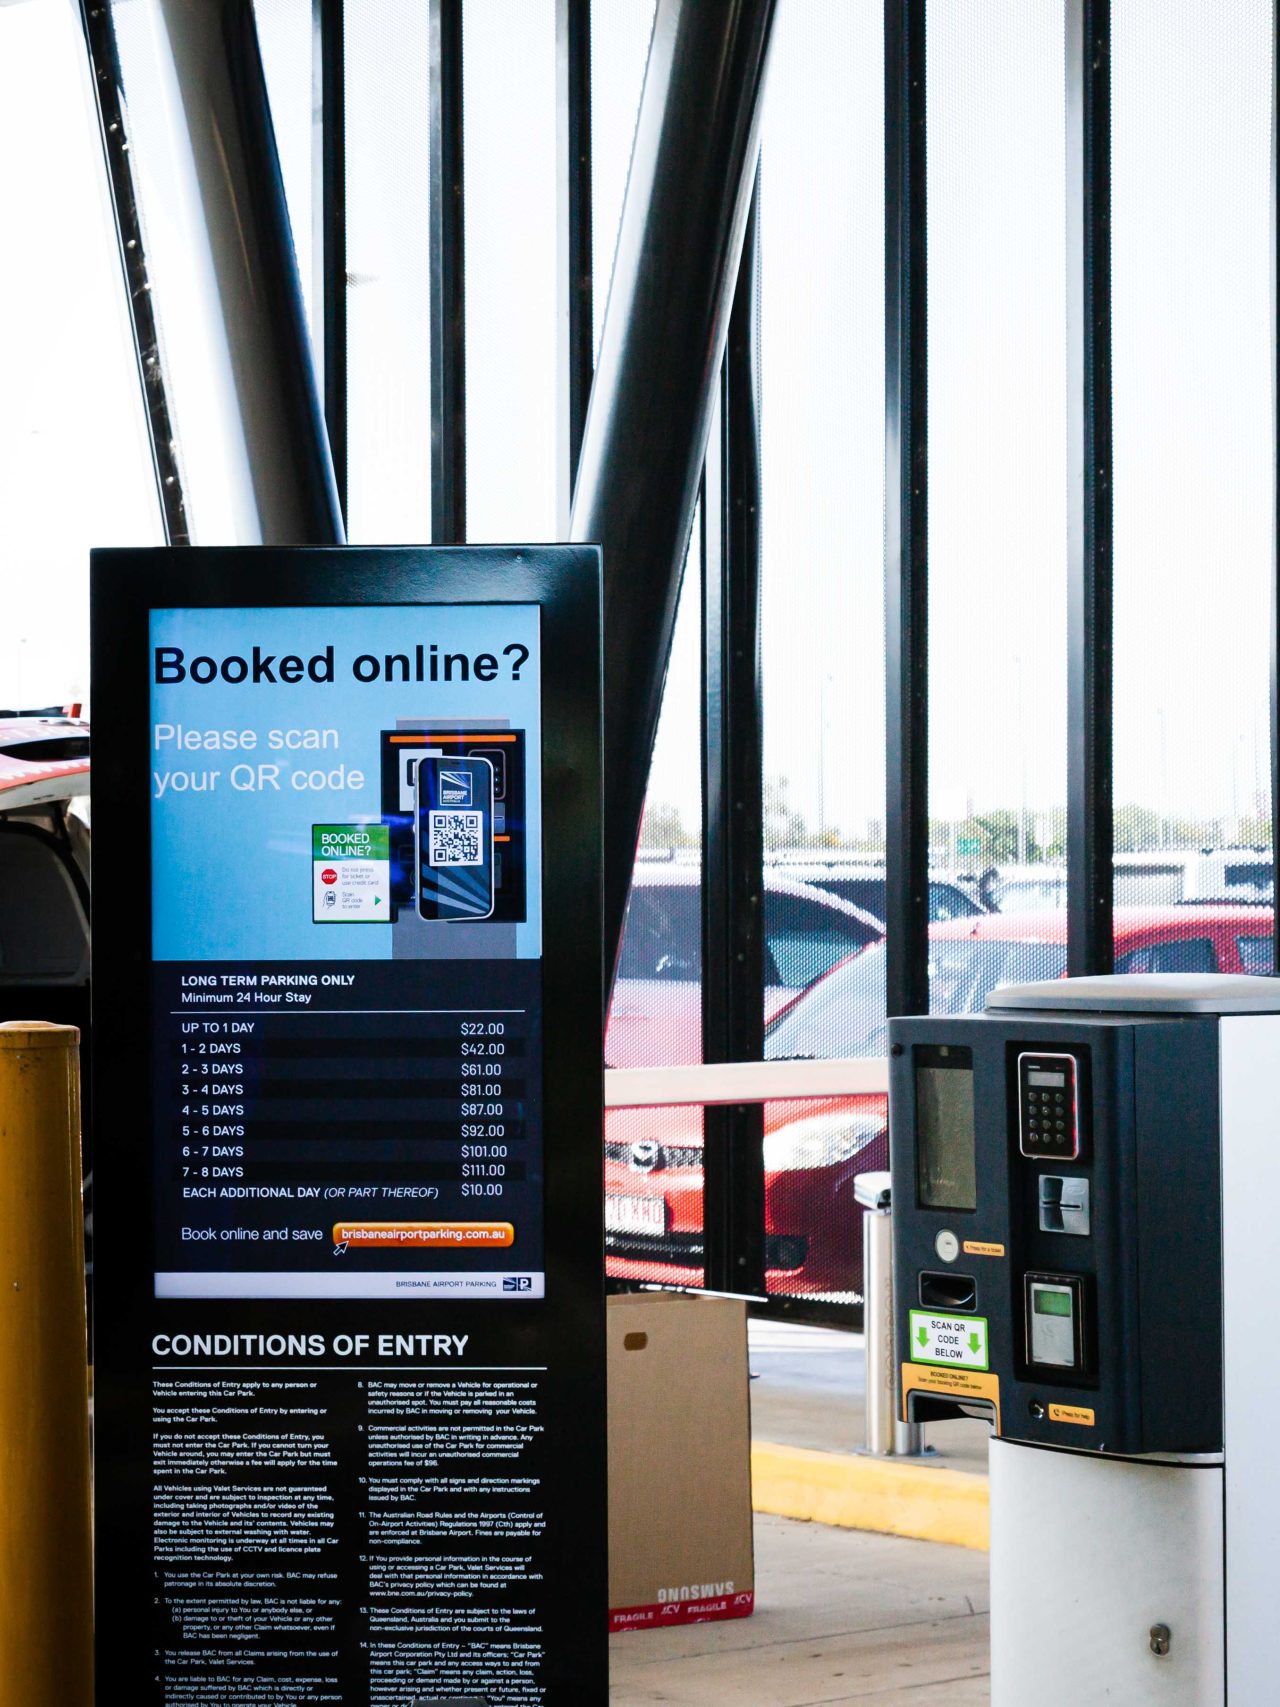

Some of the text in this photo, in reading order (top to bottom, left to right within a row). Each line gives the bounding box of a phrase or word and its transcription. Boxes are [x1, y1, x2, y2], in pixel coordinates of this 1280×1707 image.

[155, 643, 530, 684] Booked online?
[155, 724, 339, 750] Please scan
[154, 765, 365, 799] your QR code
[322, 834, 369, 844] BOOKED
[322, 846, 371, 856] ONLINE?
[182, 975, 355, 986] LONG TERM PARKING ONLY
[182, 992, 311, 1004] Minimum 24 Hour Stay
[182, 1023, 254, 1033] UP TO 1 DAY
[461, 1022, 504, 1036] $22.00
[182, 1044, 186, 1053] 1
[199, 1044, 206, 1053] 2
[210, 1043, 240, 1053] DAYS
[462, 1043, 504, 1056] $42.00
[182, 1064, 188, 1074] 2
[202, 1064, 208, 1074] 3
[212, 1064, 243, 1074] DAYS
[462, 1063, 501, 1076] $61.00
[182, 1085, 189, 1094] 3
[202, 1085, 208, 1094] 4
[212, 1084, 243, 1094] DAYS
[462, 1084, 501, 1096] $81.00
[182, 1106, 189, 1115] 4
[202, 1105, 209, 1115] 5
[213, 1105, 244, 1115] DAYS
[462, 1103, 502, 1116] $87.00
[183, 1126, 189, 1136] 5
[202, 1126, 209, 1136] 6
[214, 1126, 244, 1136] DAYS
[462, 1124, 504, 1137] $92.00
[183, 1146, 190, 1156] 6
[202, 1146, 208, 1156] 7
[213, 1146, 243, 1156] DAYS
[462, 1145, 507, 1158] $101.00
[183, 1167, 189, 1176] 7
[202, 1167, 208, 1177] 8
[213, 1167, 243, 1177] DAYS
[462, 1164, 505, 1176] $111.00
[184, 1187, 438, 1199] EACH ADDITIONAL DAY (OR PART THEREOF)
[462, 1183, 502, 1196] $10.00
[182, 1227, 323, 1240] Book online and save
[341, 1227, 505, 1242] brisbaneairportparking.com.au
[931, 1321, 965, 1333] SCAN QR
[152, 1335, 468, 1356] CONDITIONS OF ENTRY
[938, 1335, 959, 1345] CODE
[935, 1348, 962, 1359] BELOW
[931, 1371, 948, 1379] BOOKED
[658, 1581, 734, 1602] SAMSUNG
[614, 1612, 654, 1623] FRAGILE
[688, 1601, 727, 1614] FRAGILE
